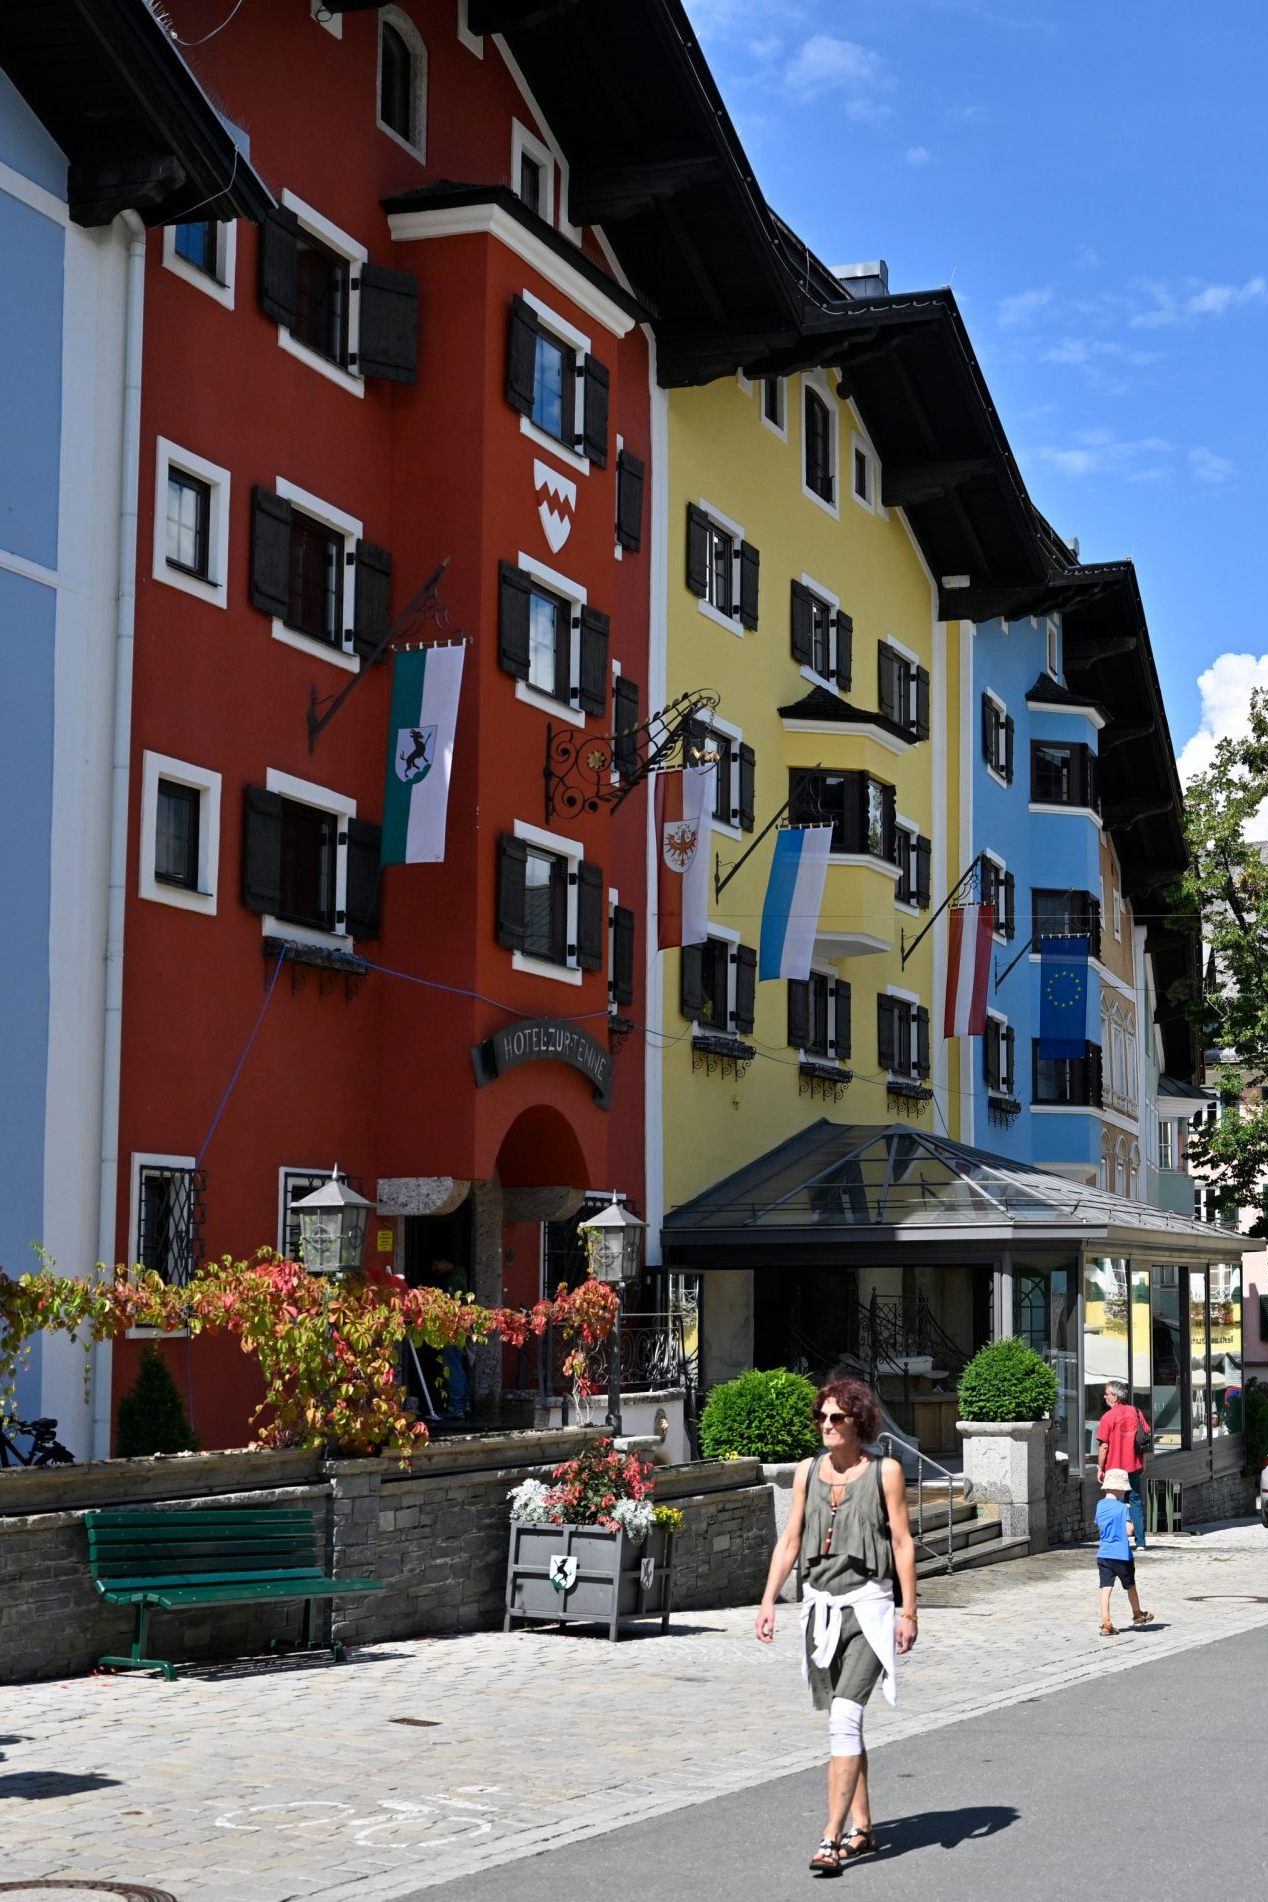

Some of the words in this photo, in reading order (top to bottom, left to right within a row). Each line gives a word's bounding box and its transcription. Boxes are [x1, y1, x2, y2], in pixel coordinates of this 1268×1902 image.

[503, 1028, 546, 1060] HOTEL
[548, 1028, 571, 1055] ZUR
[571, 1034, 607, 1080] TENNE
